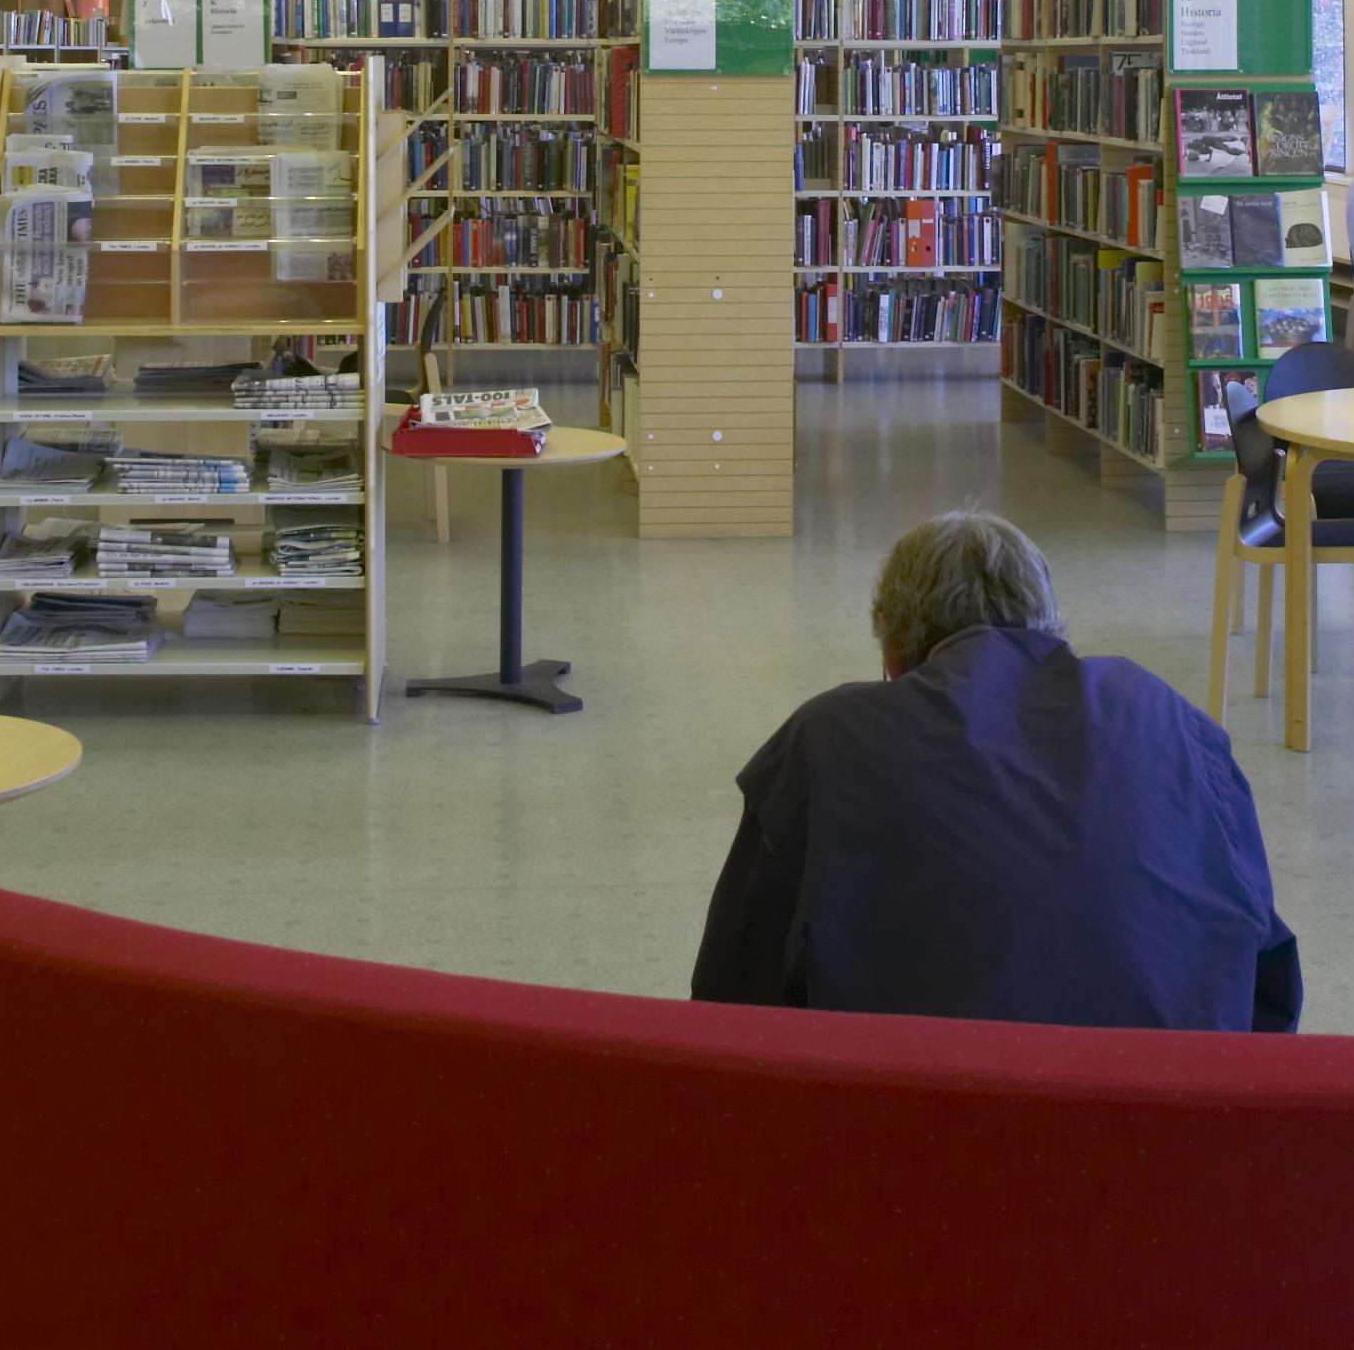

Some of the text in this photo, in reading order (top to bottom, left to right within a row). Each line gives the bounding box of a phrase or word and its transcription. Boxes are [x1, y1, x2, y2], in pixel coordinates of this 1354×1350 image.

[1181, 7, 1222, 18] Historia
[15, 208, 29, 305] THE IMES
[432, 392, 510, 407] 100-TALS
